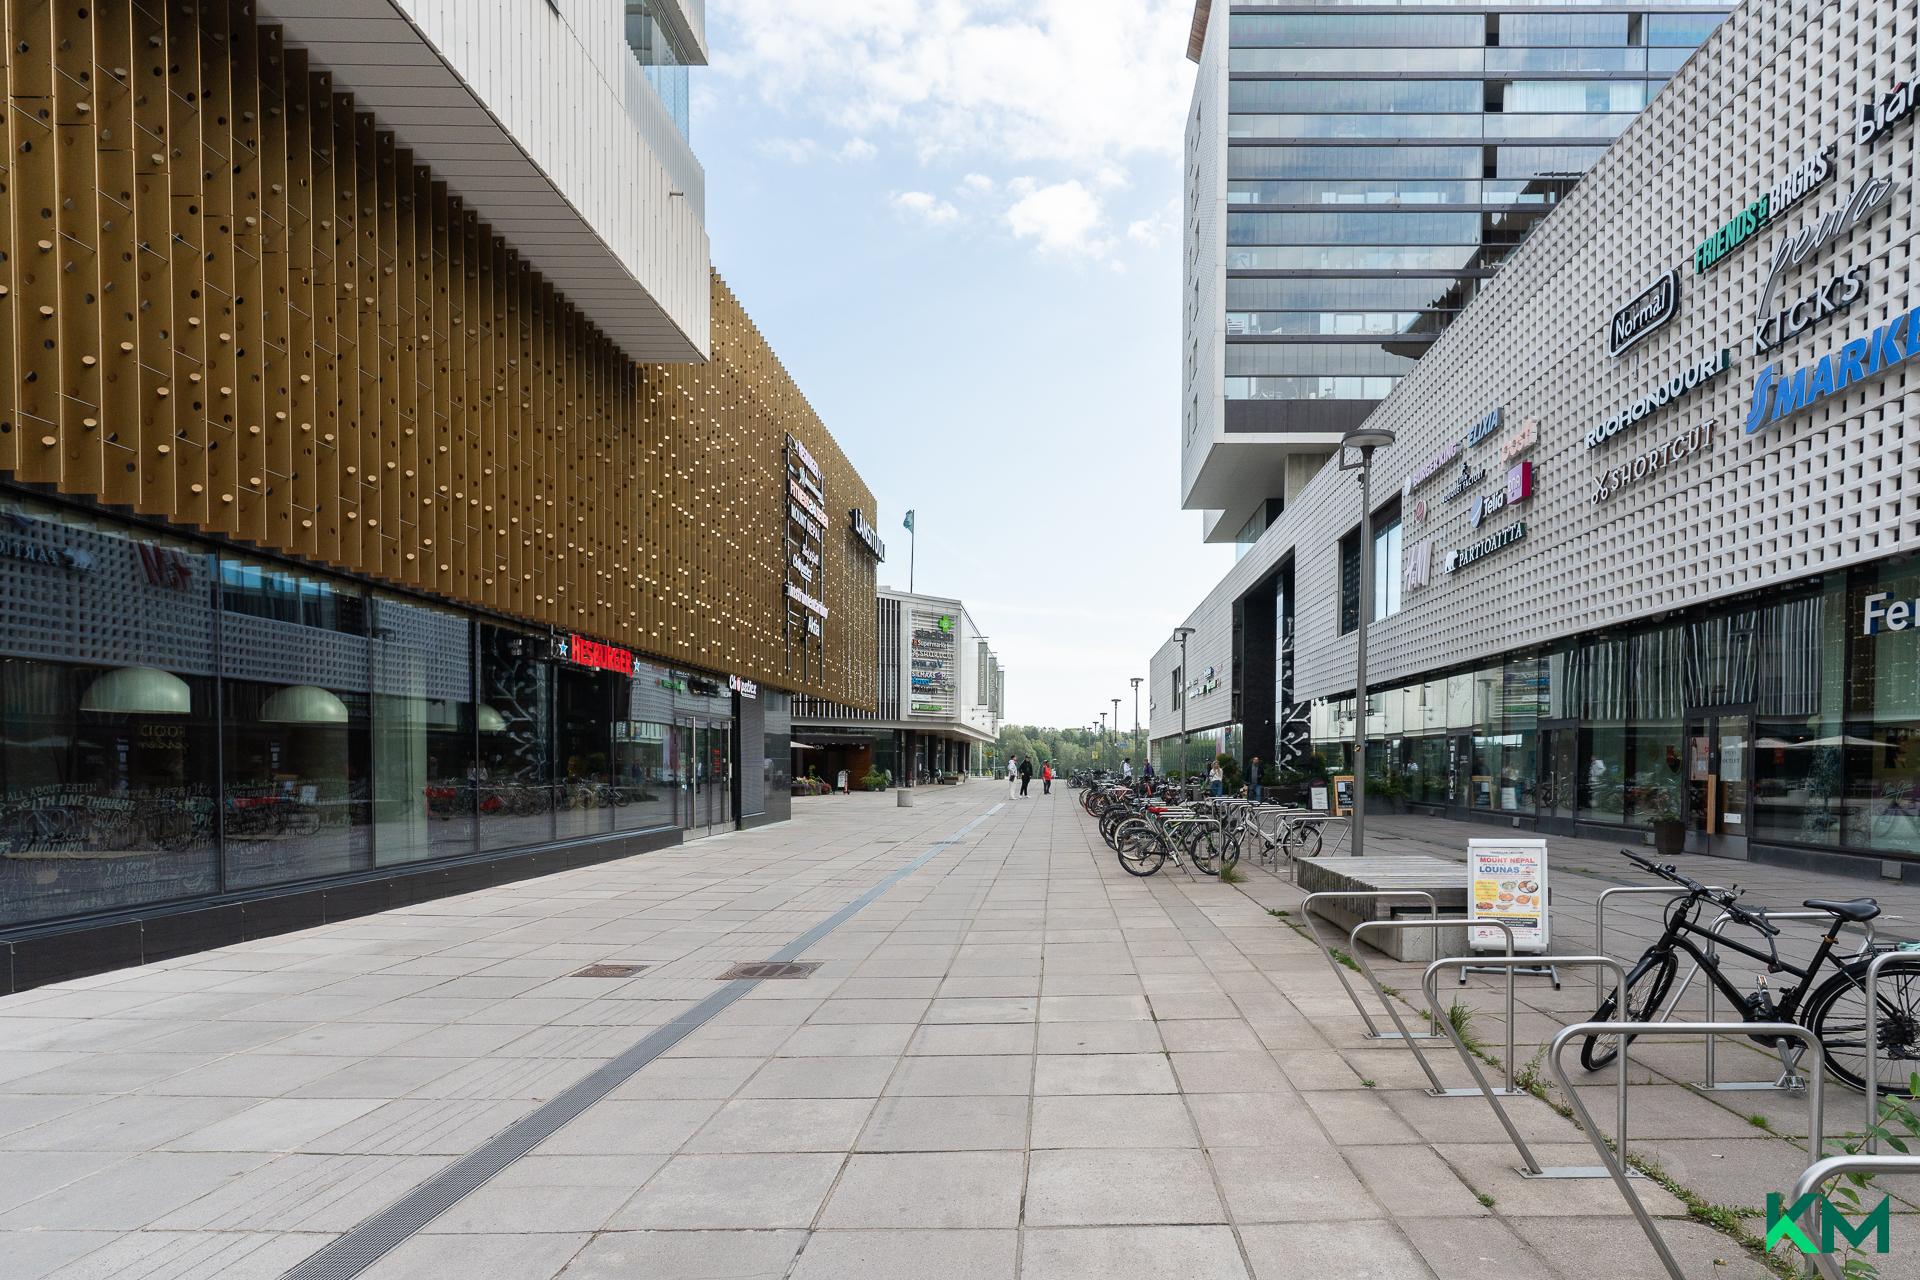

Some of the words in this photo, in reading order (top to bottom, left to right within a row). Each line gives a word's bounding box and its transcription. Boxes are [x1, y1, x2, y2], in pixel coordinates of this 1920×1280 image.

[1695, 201, 1758, 274] FRIENDS
[1768, 145, 1829, 218] BRGRS
[1616, 283, 1667, 348] Normal
[1751, 265, 1861, 355] KICKS
[1585, 350, 1726, 449] RUOHONJUURI
[1468, 410, 1499, 447] ELIXIA
[1611, 420, 1714, 493] SHORTCUT
[1482, 491, 1505, 518] Telia
[1458, 520, 1522, 567] PARTIOAITTA
[1864, 592, 1920, 634] Fe
[571, 633, 633, 678] HESBURGER
[1479, 865, 1520, 874] LOUNAS
